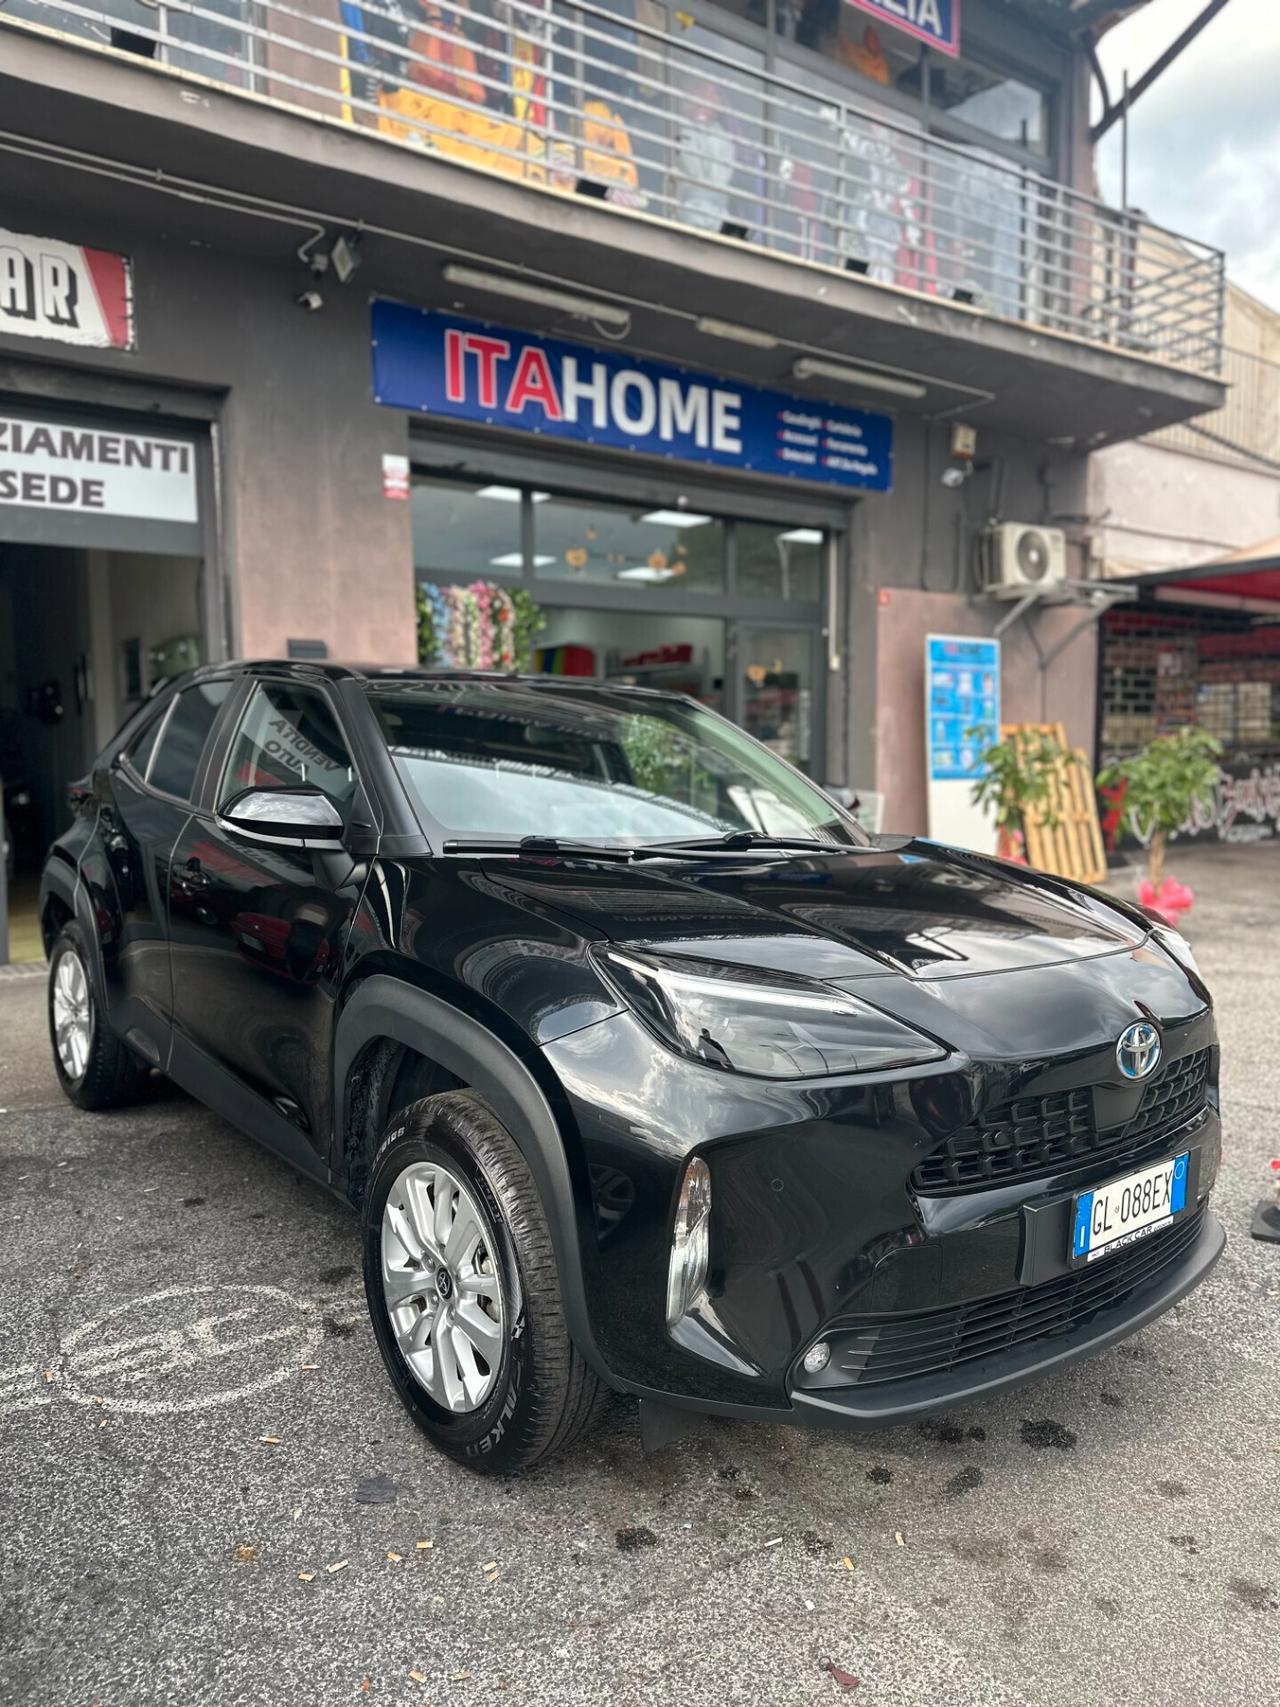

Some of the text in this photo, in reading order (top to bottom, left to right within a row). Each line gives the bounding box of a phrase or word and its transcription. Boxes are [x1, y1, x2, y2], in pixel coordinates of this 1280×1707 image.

[444, 328, 742, 453] ITAHOME
[0, 470, 105, 507] SEDE
[1093, 1169, 1173, 1235] GL 088EX
[1104, 1235, 1133, 1253] BLACK
[1134, 1225, 1153, 1240] CAR
